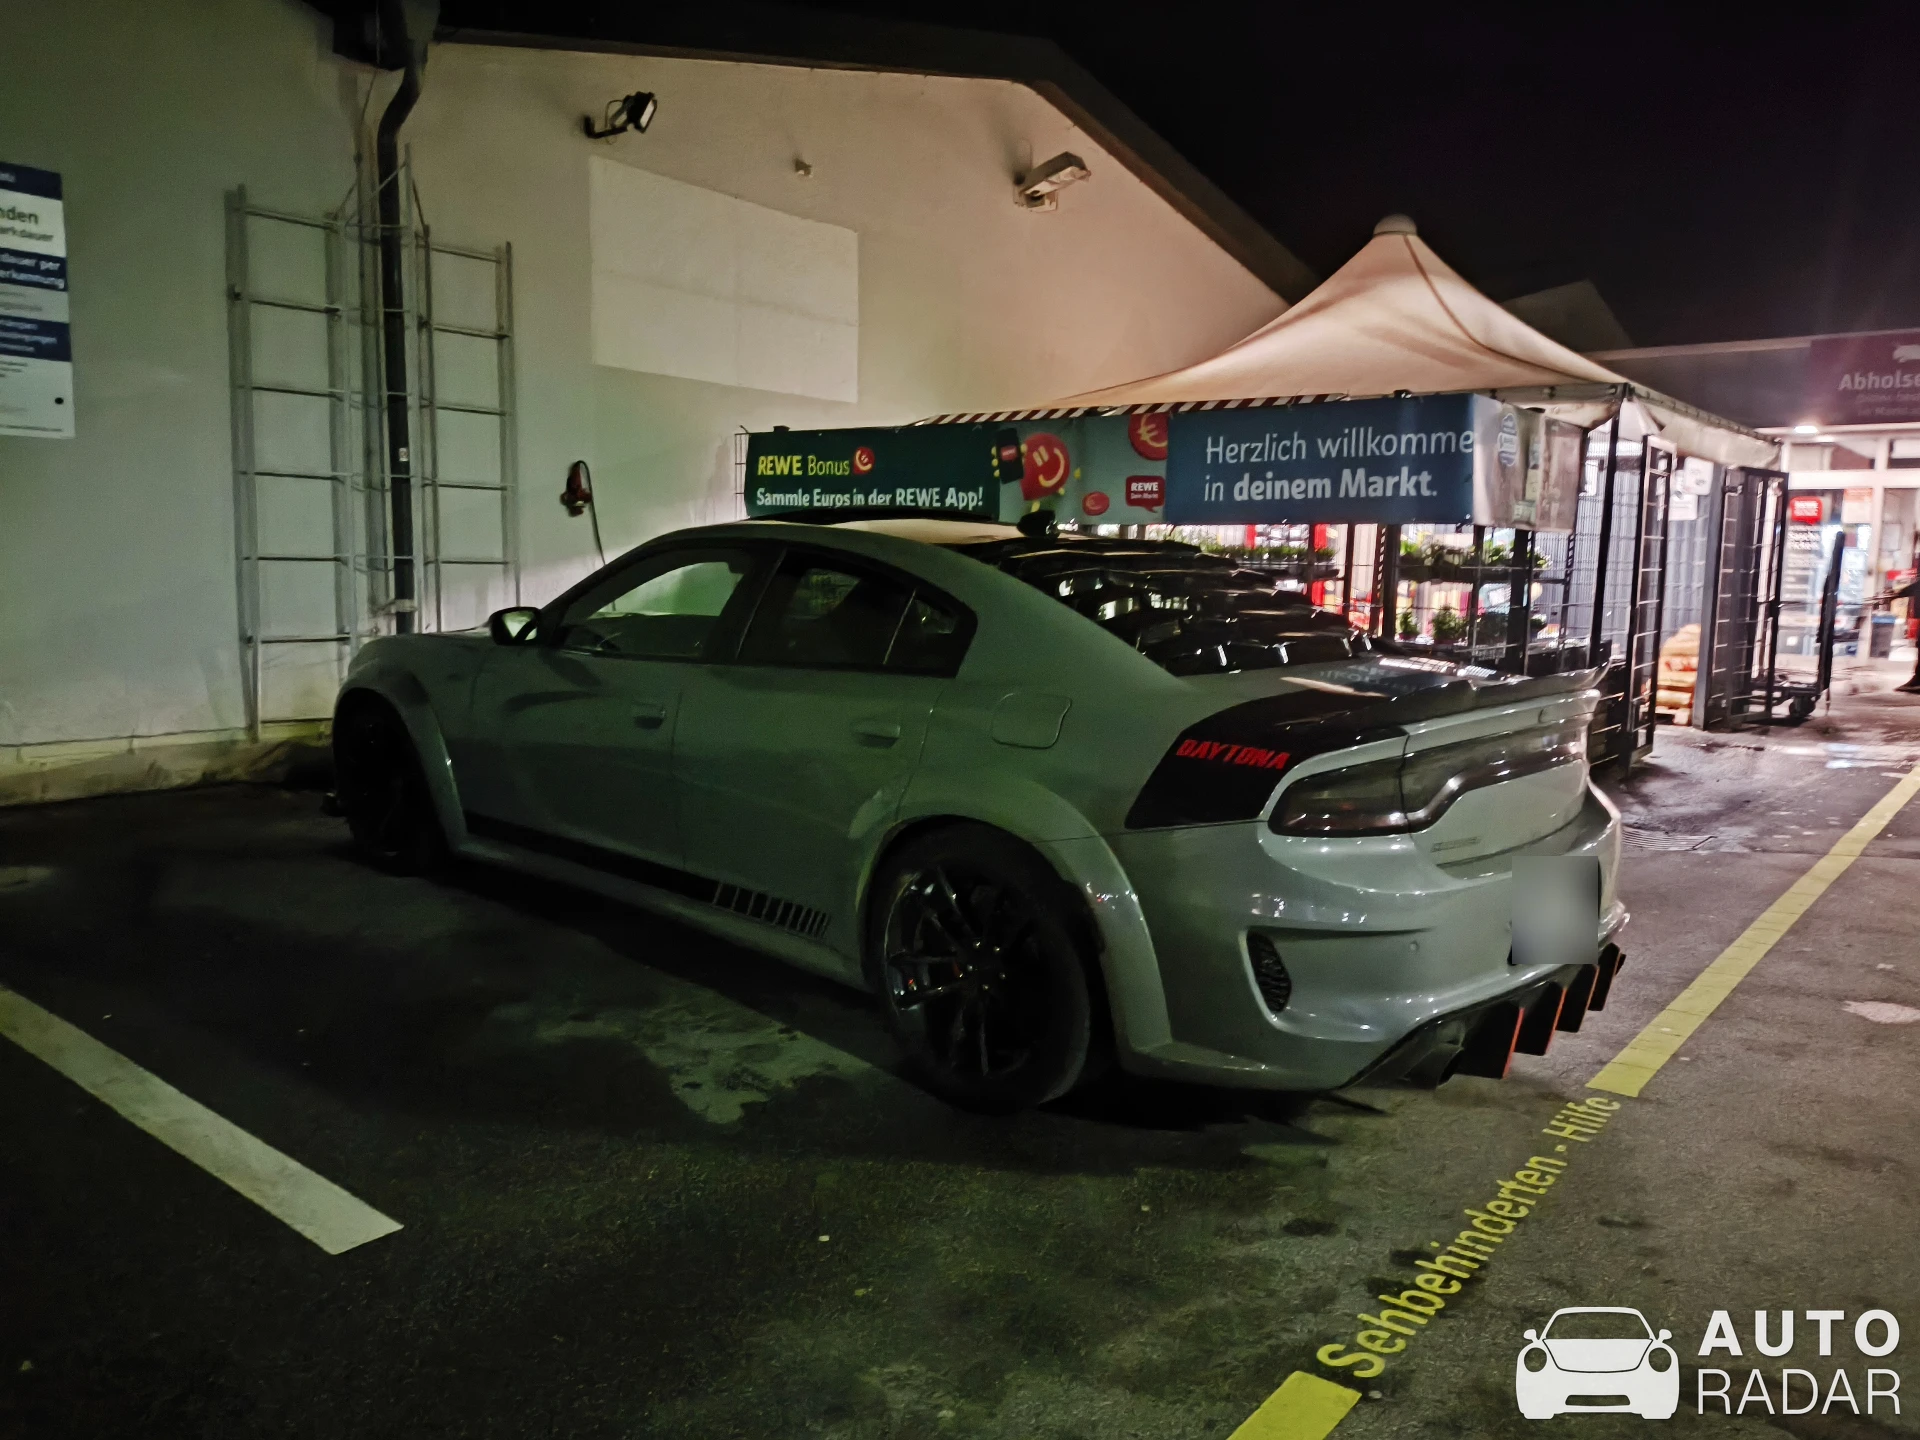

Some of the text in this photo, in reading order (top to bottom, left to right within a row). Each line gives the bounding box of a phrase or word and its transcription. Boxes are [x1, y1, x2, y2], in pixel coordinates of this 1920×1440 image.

[1206, 431, 1306, 464] Herzlich
[1317, 426, 1474, 459] willkomme
[757, 455, 850, 476] REWE Bonus
[756, 486, 983, 511] Sammle Euros in der REWE App!
[1130, 481, 1159, 492] REWE
[1204, 466, 1438, 501] in deinem Markt.
[1176, 739, 1291, 770] DAYTONA
[1316, 1155, 1568, 1378] Sehbehinderten
[1541, 1096, 1621, 1143] Hilfe
